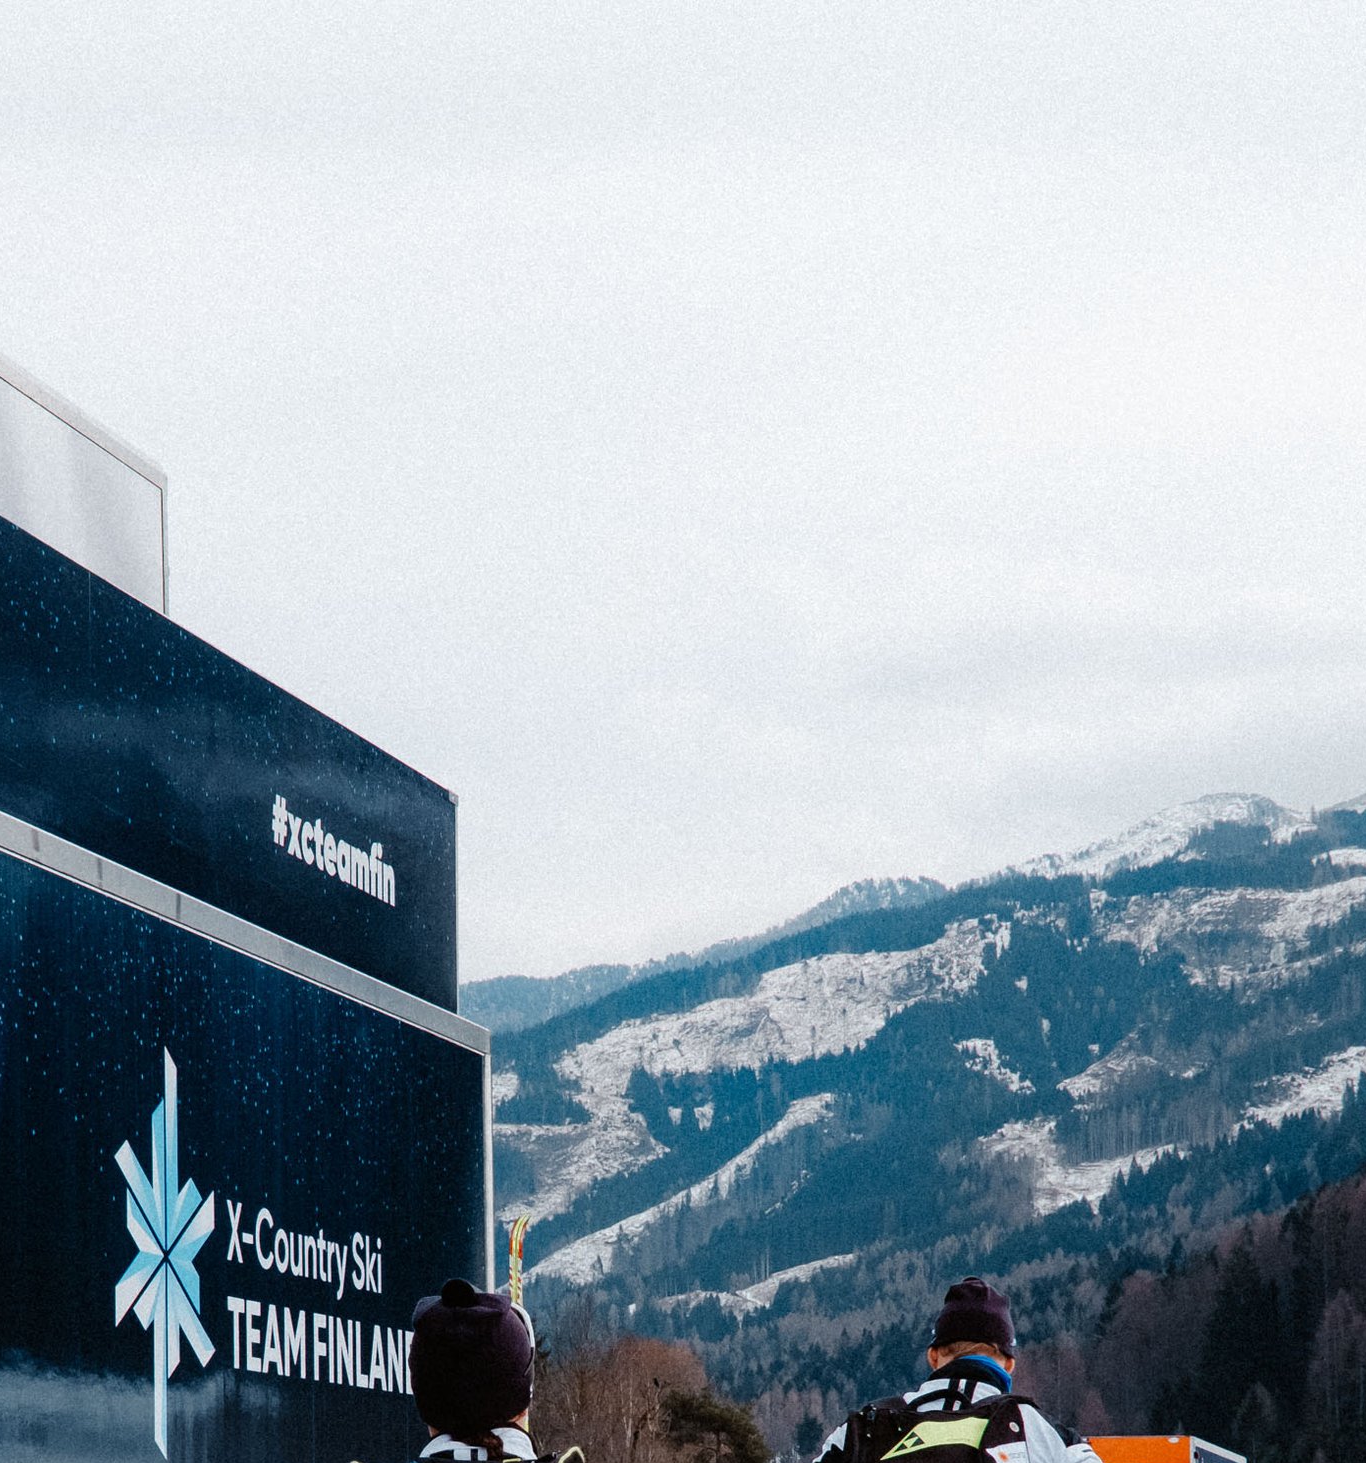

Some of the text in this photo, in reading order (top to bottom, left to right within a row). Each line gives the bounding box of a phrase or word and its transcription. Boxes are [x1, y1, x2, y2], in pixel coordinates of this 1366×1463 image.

[272, 794, 396, 907] #xcteamfin
[227, 1199, 383, 1300] X-Country Ski
[227, 1296, 307, 1379] TEAM
